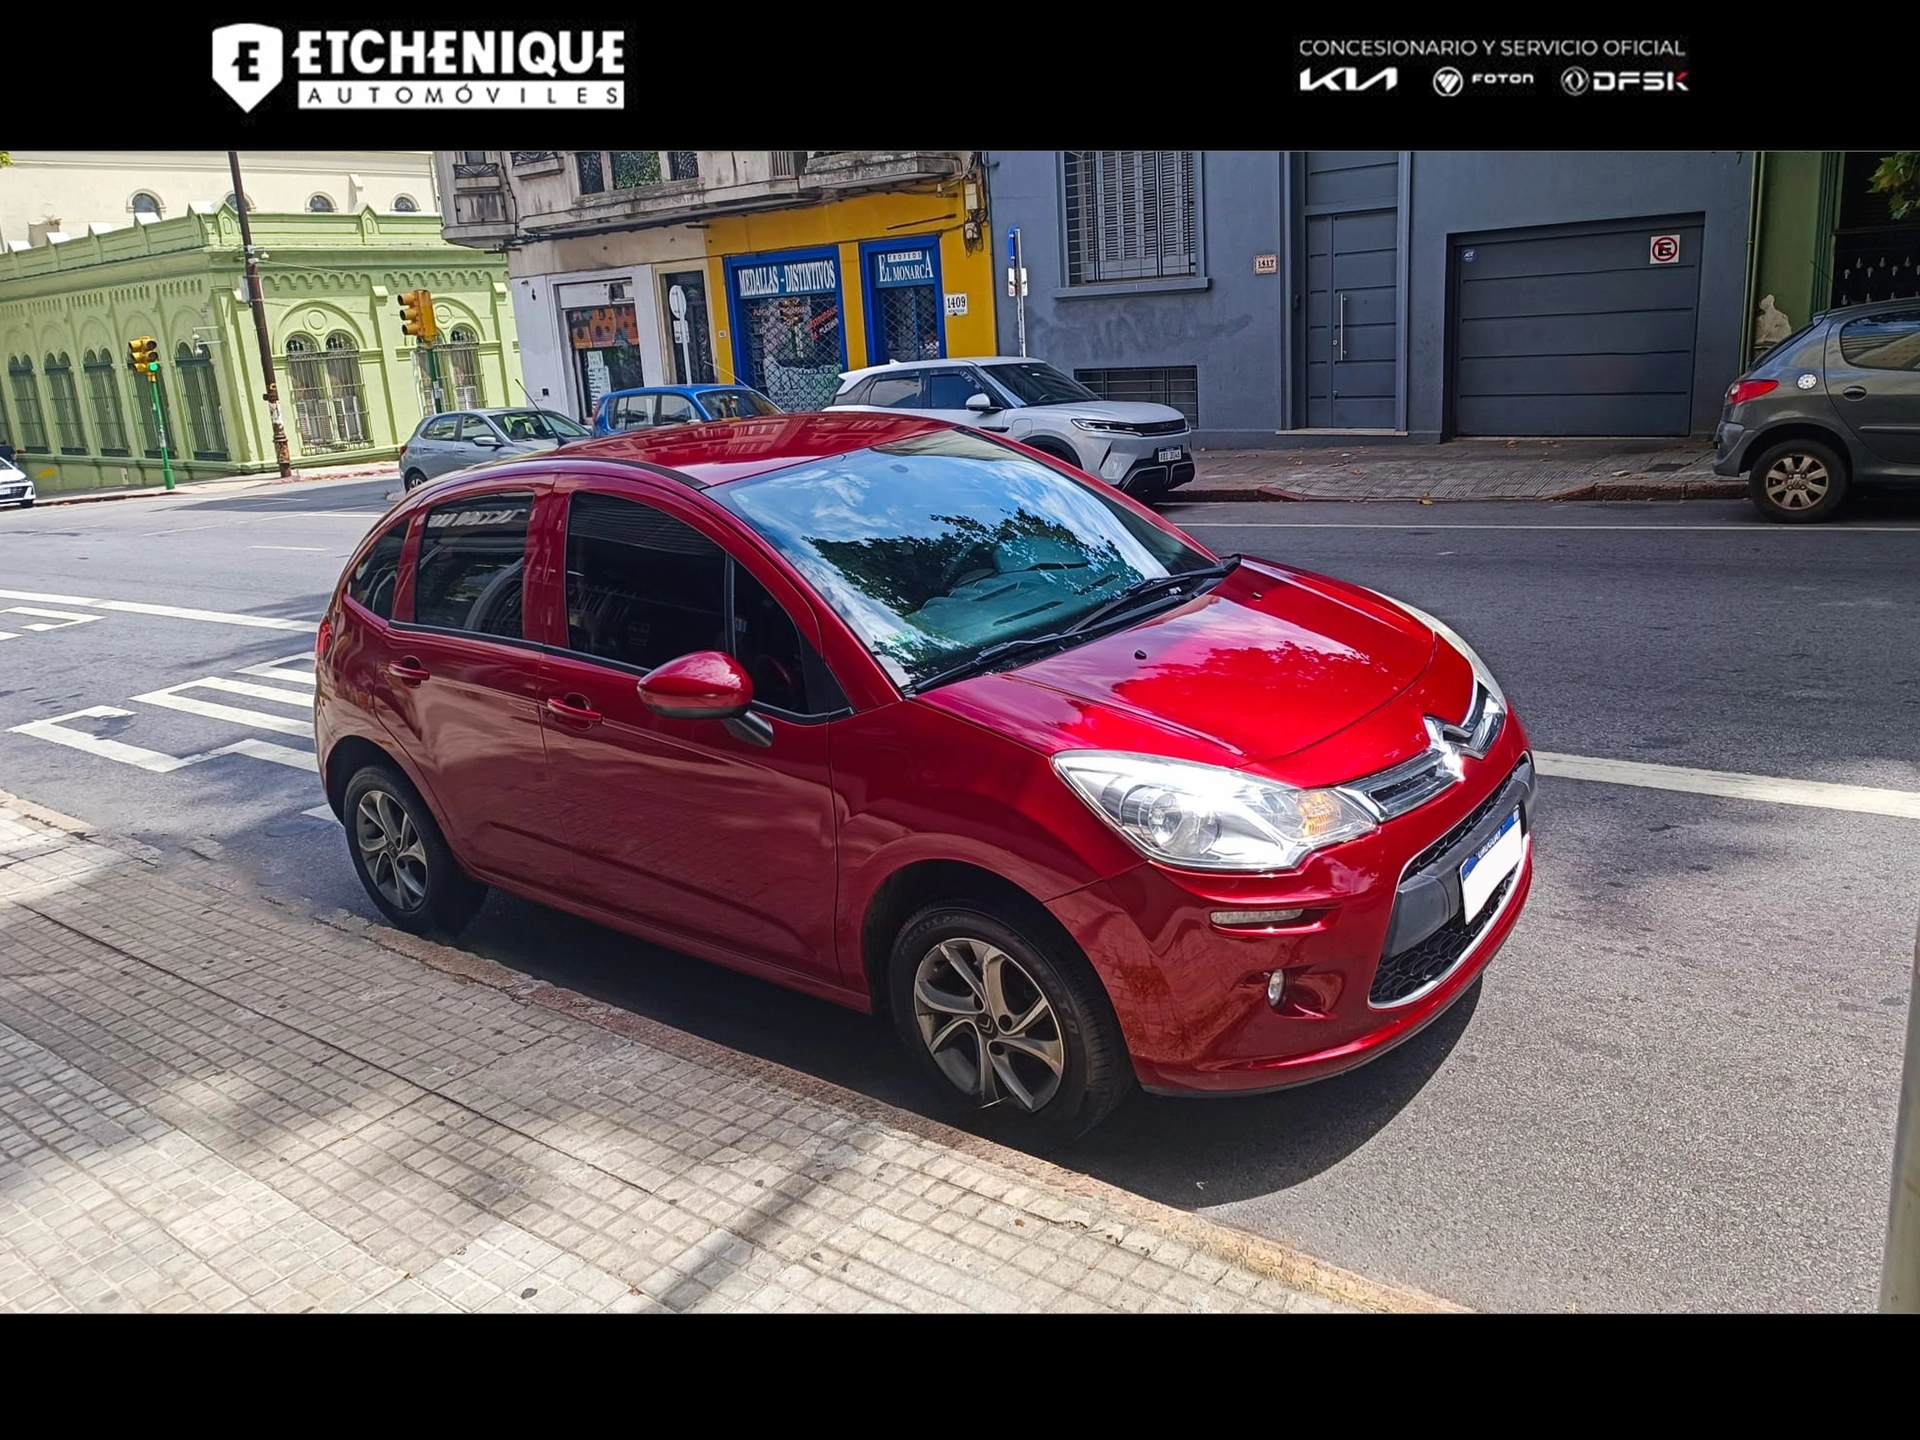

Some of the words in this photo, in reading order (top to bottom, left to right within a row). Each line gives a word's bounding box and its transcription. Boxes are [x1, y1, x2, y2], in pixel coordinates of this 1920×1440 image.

[738, 265, 780, 297] MEDALLAS
[783, 260, 836, 293] DISTINTIVOS
[947, 296, 966, 308] 1409
